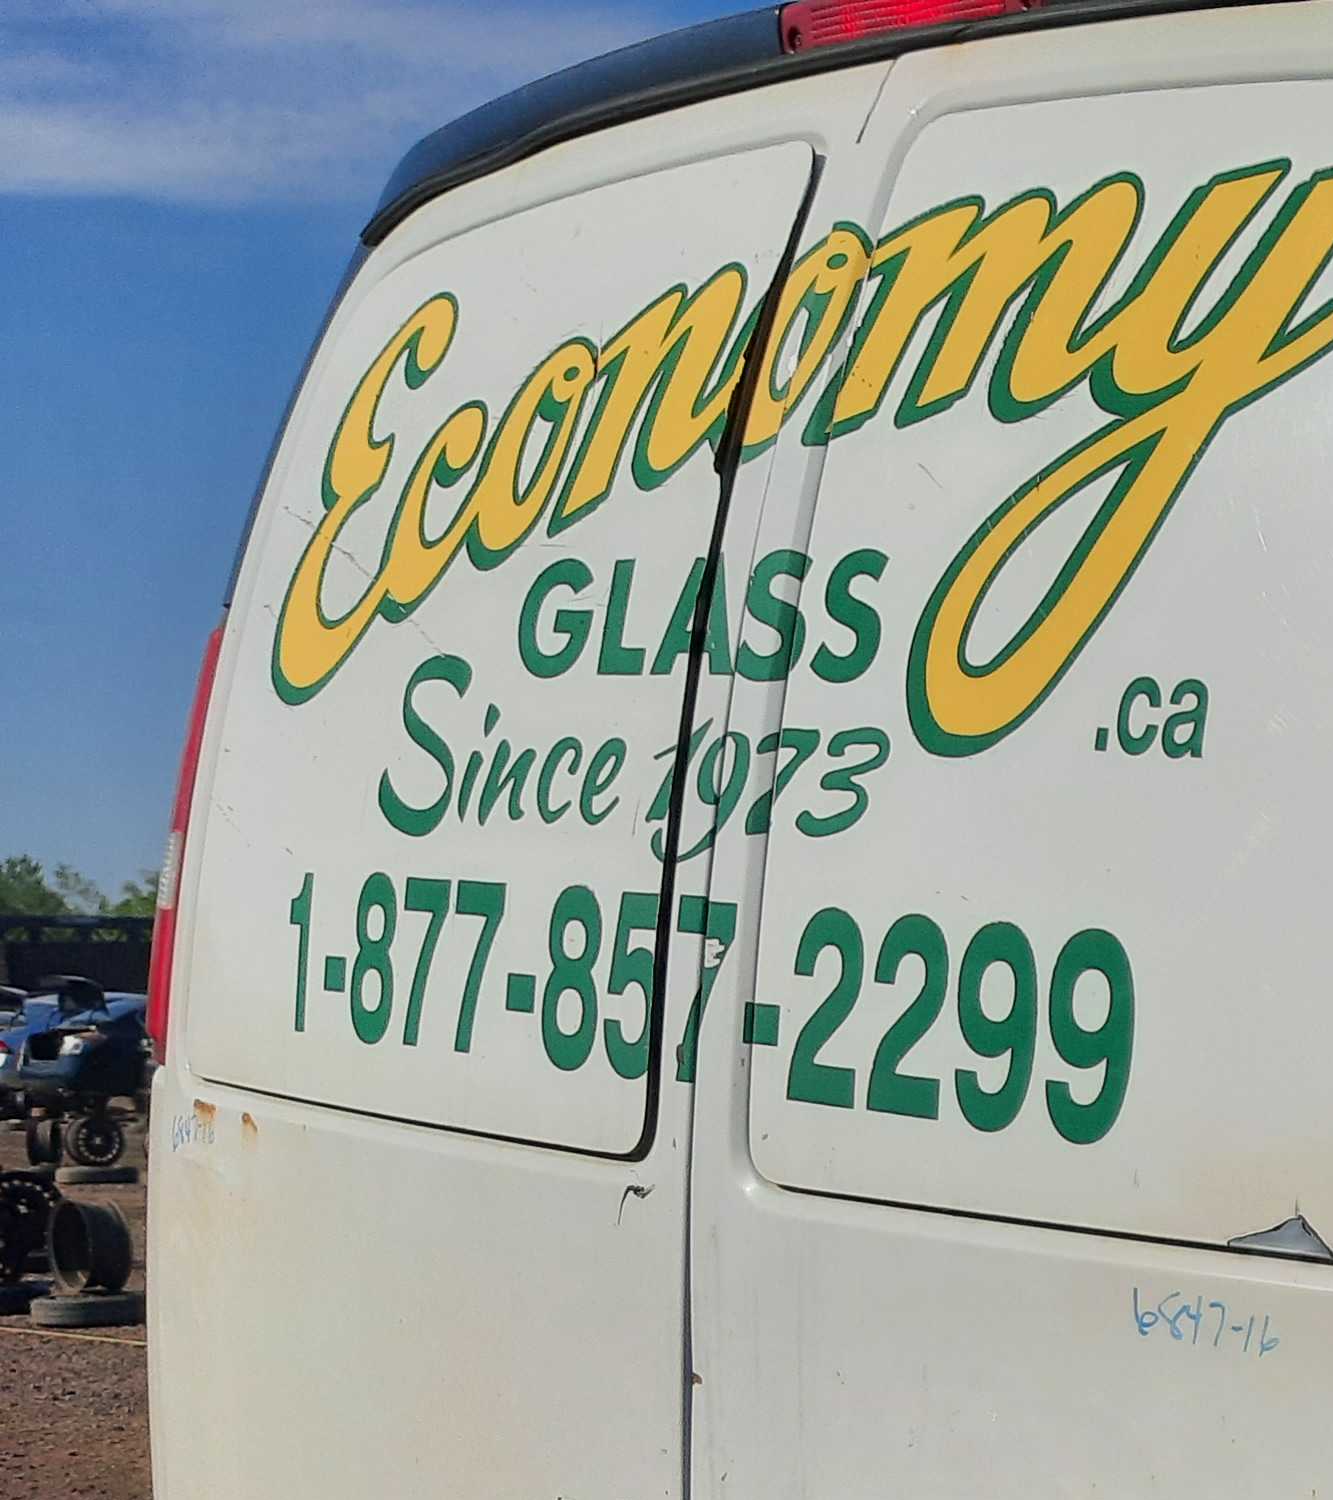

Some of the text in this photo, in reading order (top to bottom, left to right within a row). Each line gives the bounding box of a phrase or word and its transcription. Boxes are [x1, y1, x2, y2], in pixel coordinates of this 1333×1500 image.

[519, 548, 887, 681] GLASS
[378, 655, 891, 862] Since 1973
[1093, 674, 1209, 758] .ca
[289, 872, 1135, 1144] 1-877-857-2299
[1132, 1287, 1280, 1358] 6847-16
